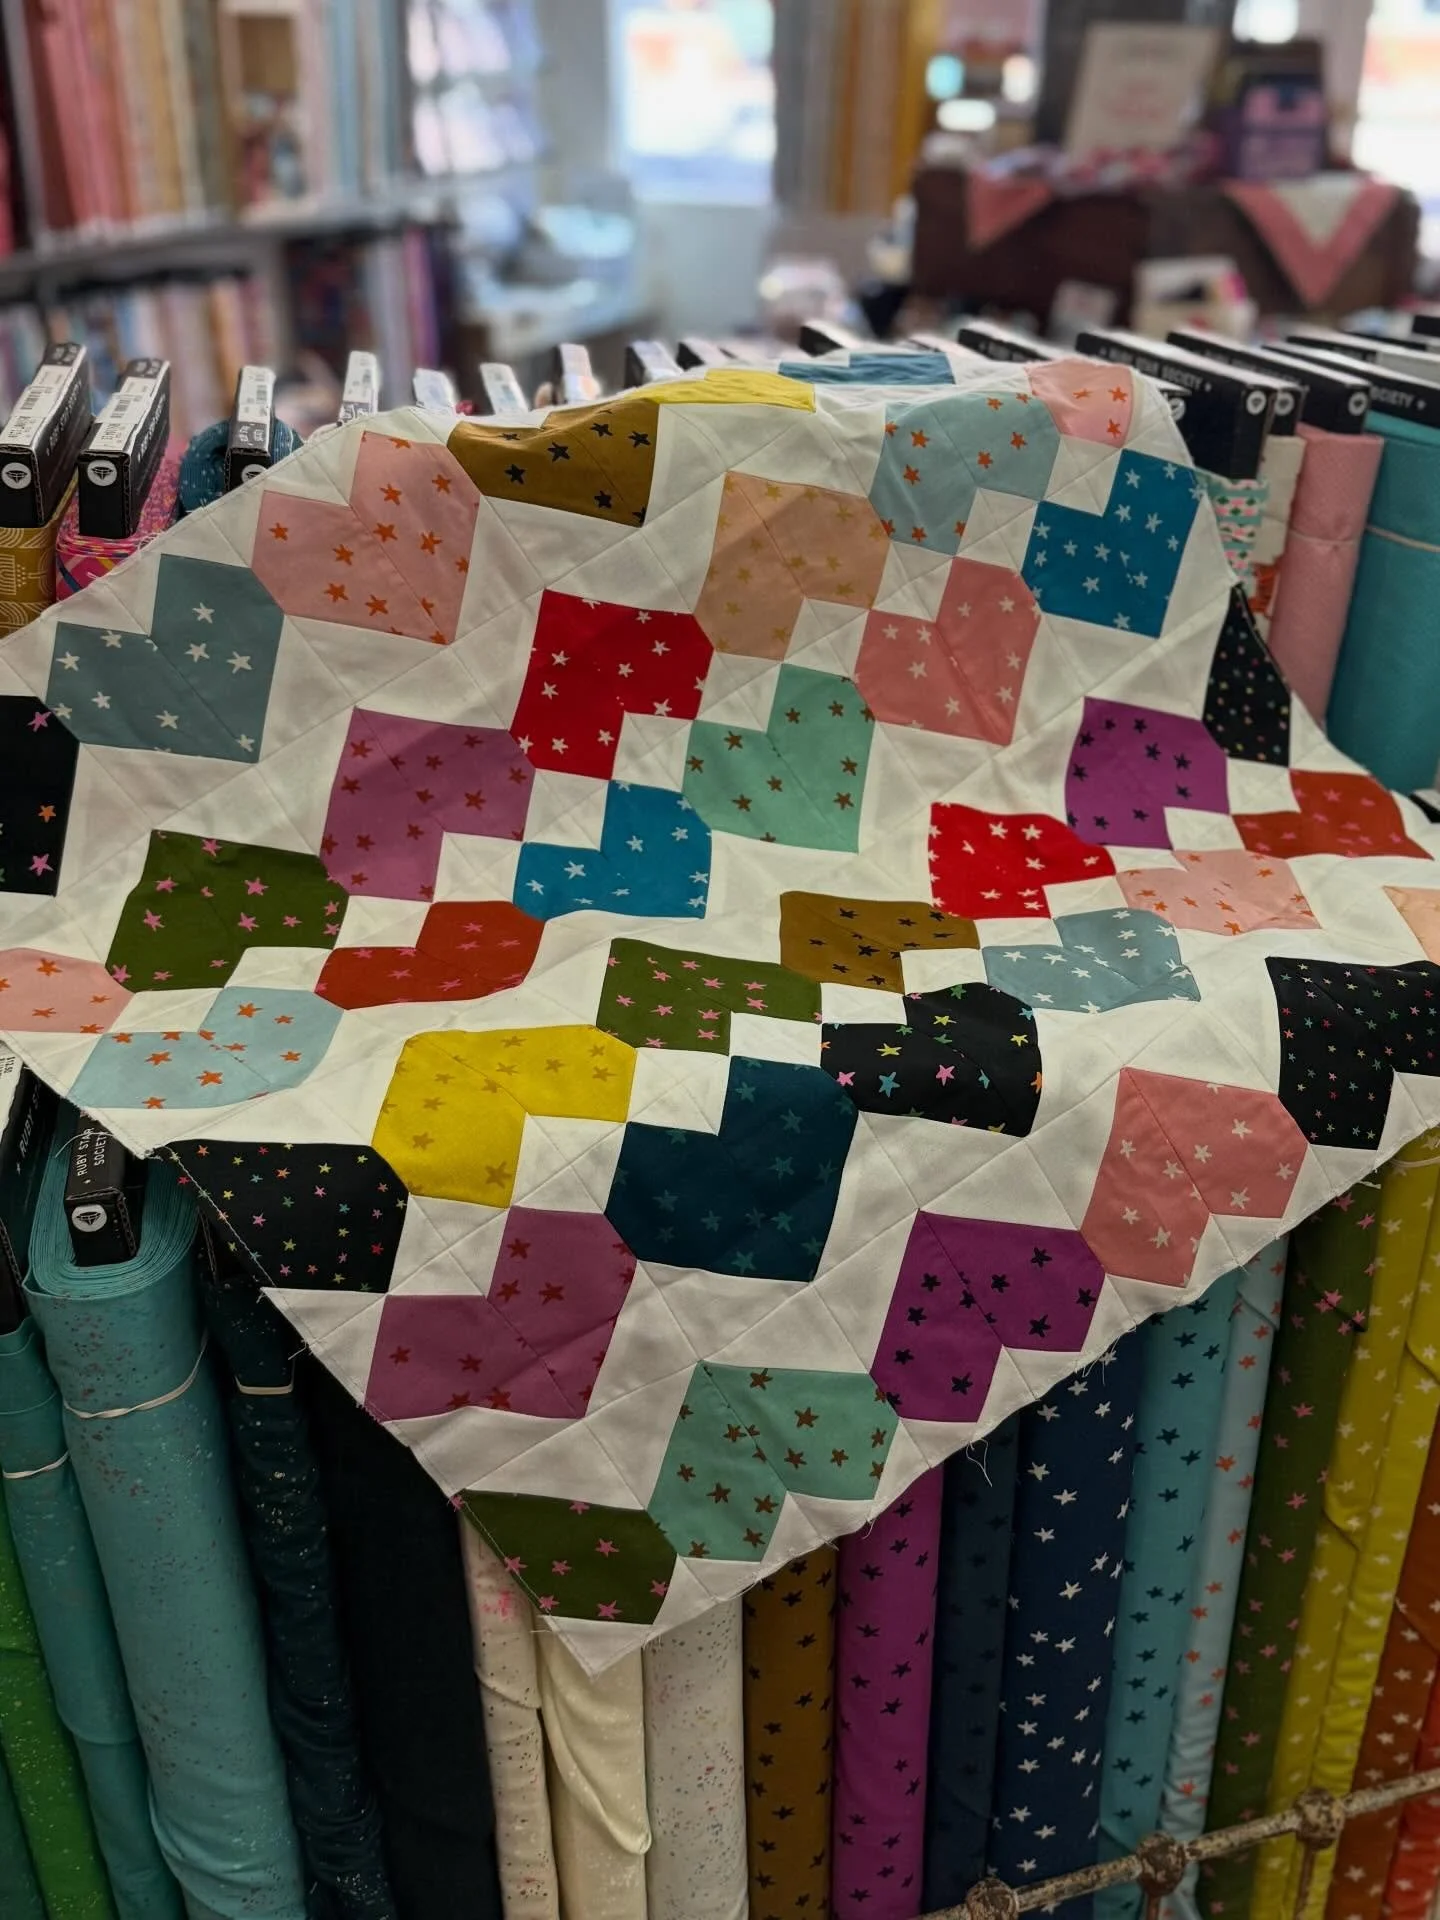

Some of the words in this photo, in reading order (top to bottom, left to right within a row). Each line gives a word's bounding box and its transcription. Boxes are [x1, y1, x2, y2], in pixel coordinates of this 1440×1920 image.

[19, 1106, 34, 1158] RUBY
[78, 1127, 95, 1151] STAR
[76, 1153, 88, 1177] RUBY
